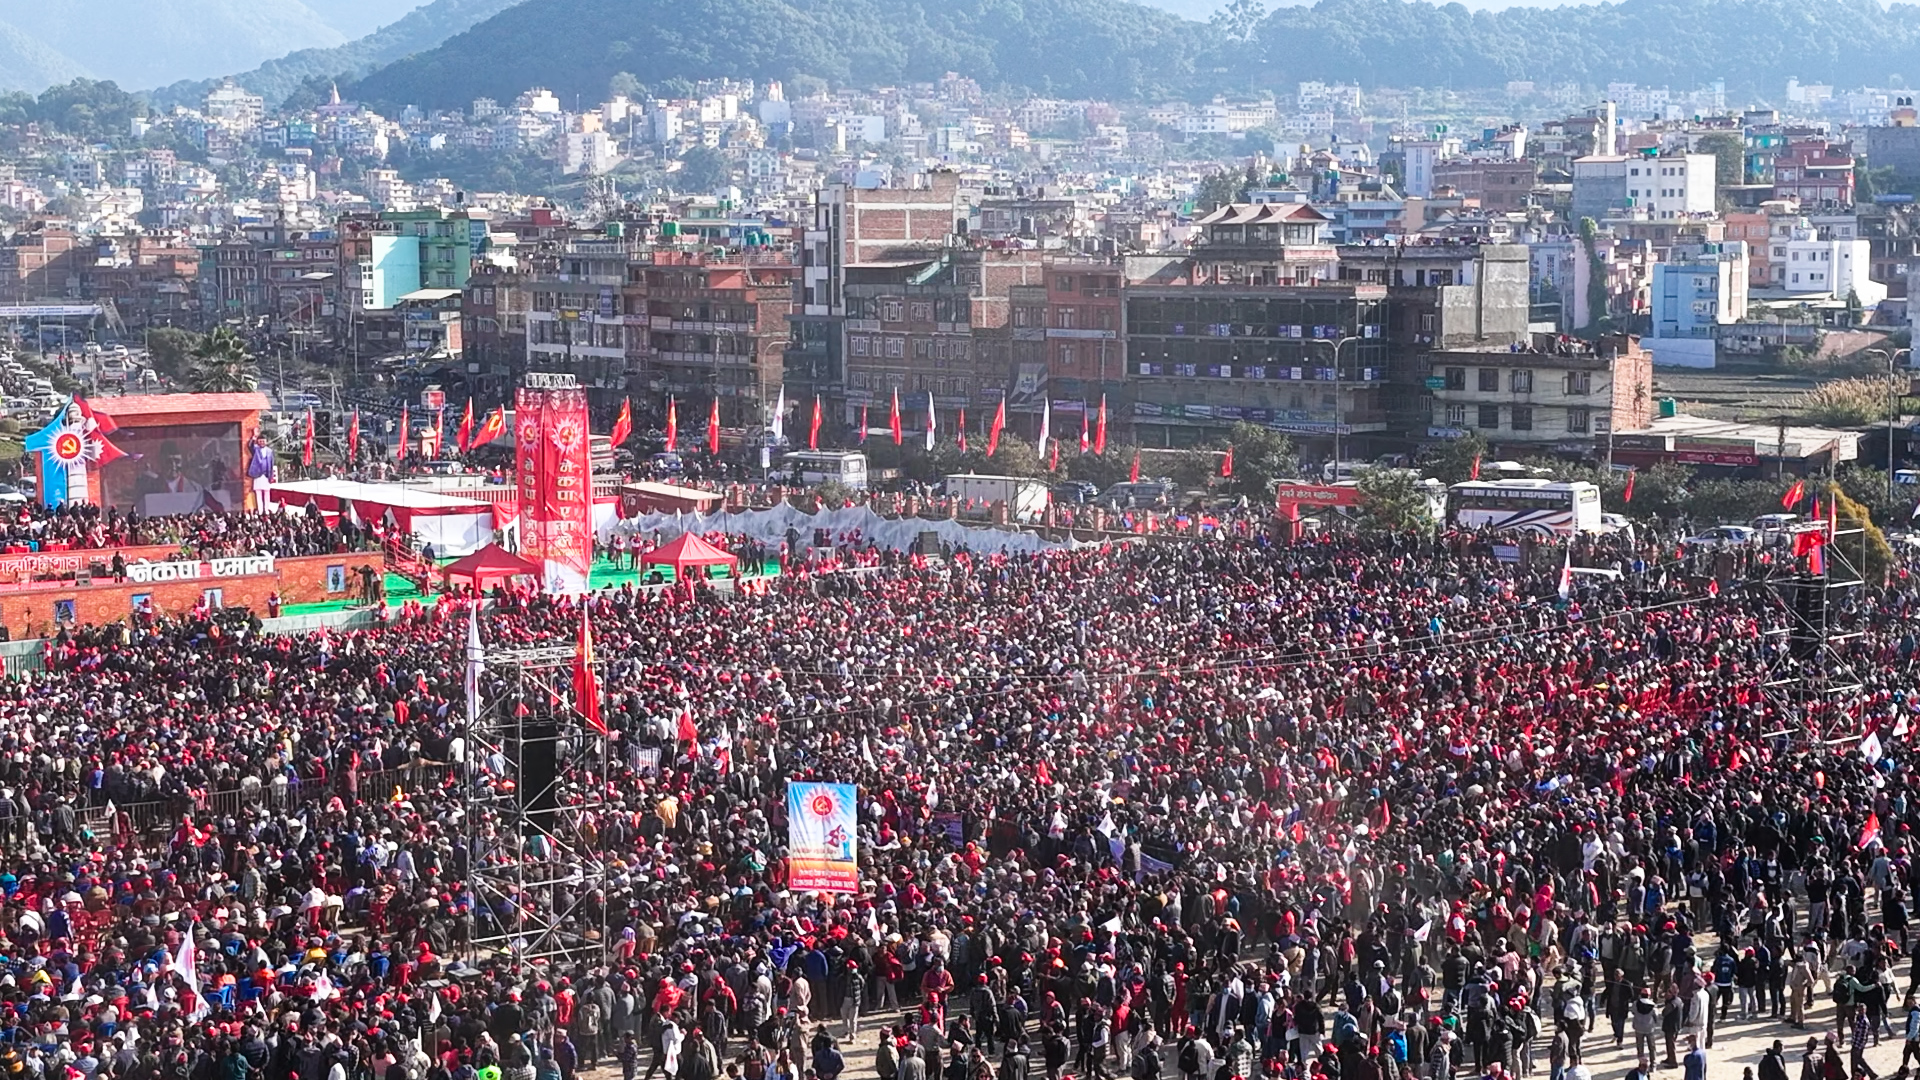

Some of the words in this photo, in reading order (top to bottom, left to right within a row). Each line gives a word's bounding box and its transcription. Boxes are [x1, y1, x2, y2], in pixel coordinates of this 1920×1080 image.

[1521, 491, 1562, 500] SUSPENSION
[133, 557, 200, 582] नेकपा
[210, 550, 275, 577] एमाले
